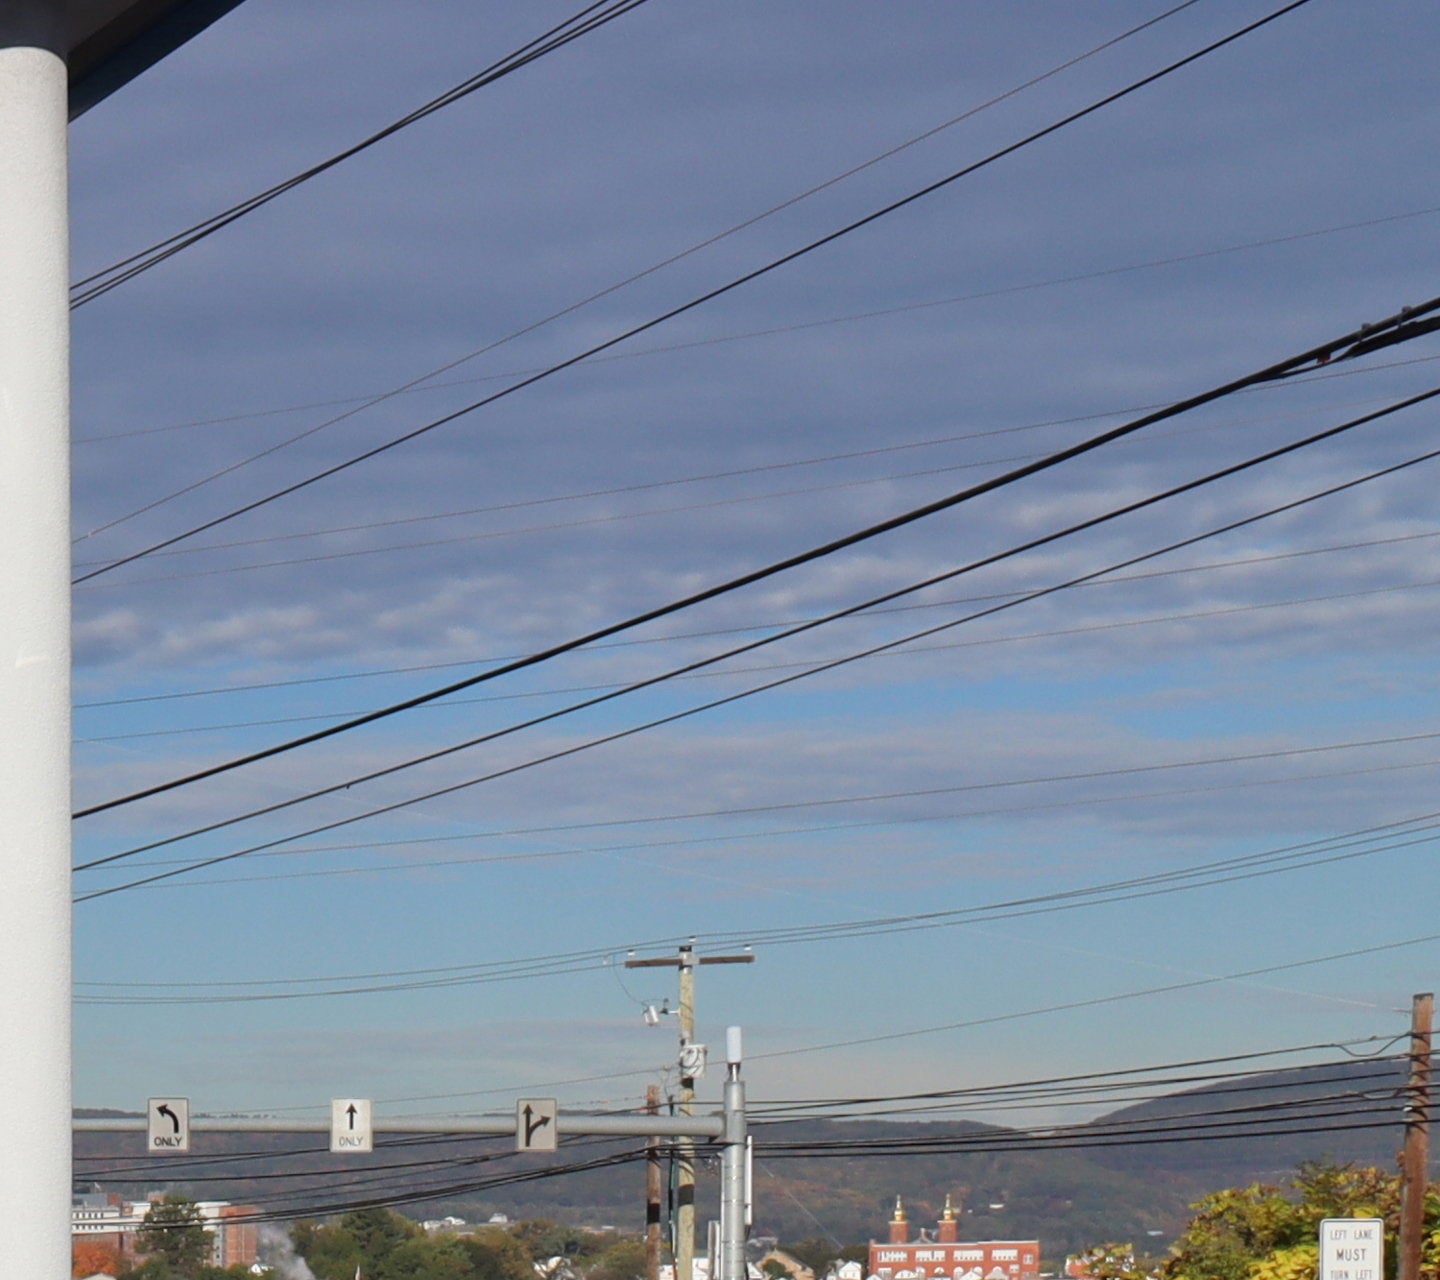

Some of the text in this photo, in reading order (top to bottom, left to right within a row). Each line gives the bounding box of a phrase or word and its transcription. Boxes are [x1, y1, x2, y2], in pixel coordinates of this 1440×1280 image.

[153, 1136, 183, 1147] ONLY
[338, 1136, 364, 1147] ONLY
[1330, 1230, 1373, 1240] LEFT LANE
[1336, 1249, 1367, 1261] MUST
[1331, 1270, 1373, 1280] TURN LEFT
